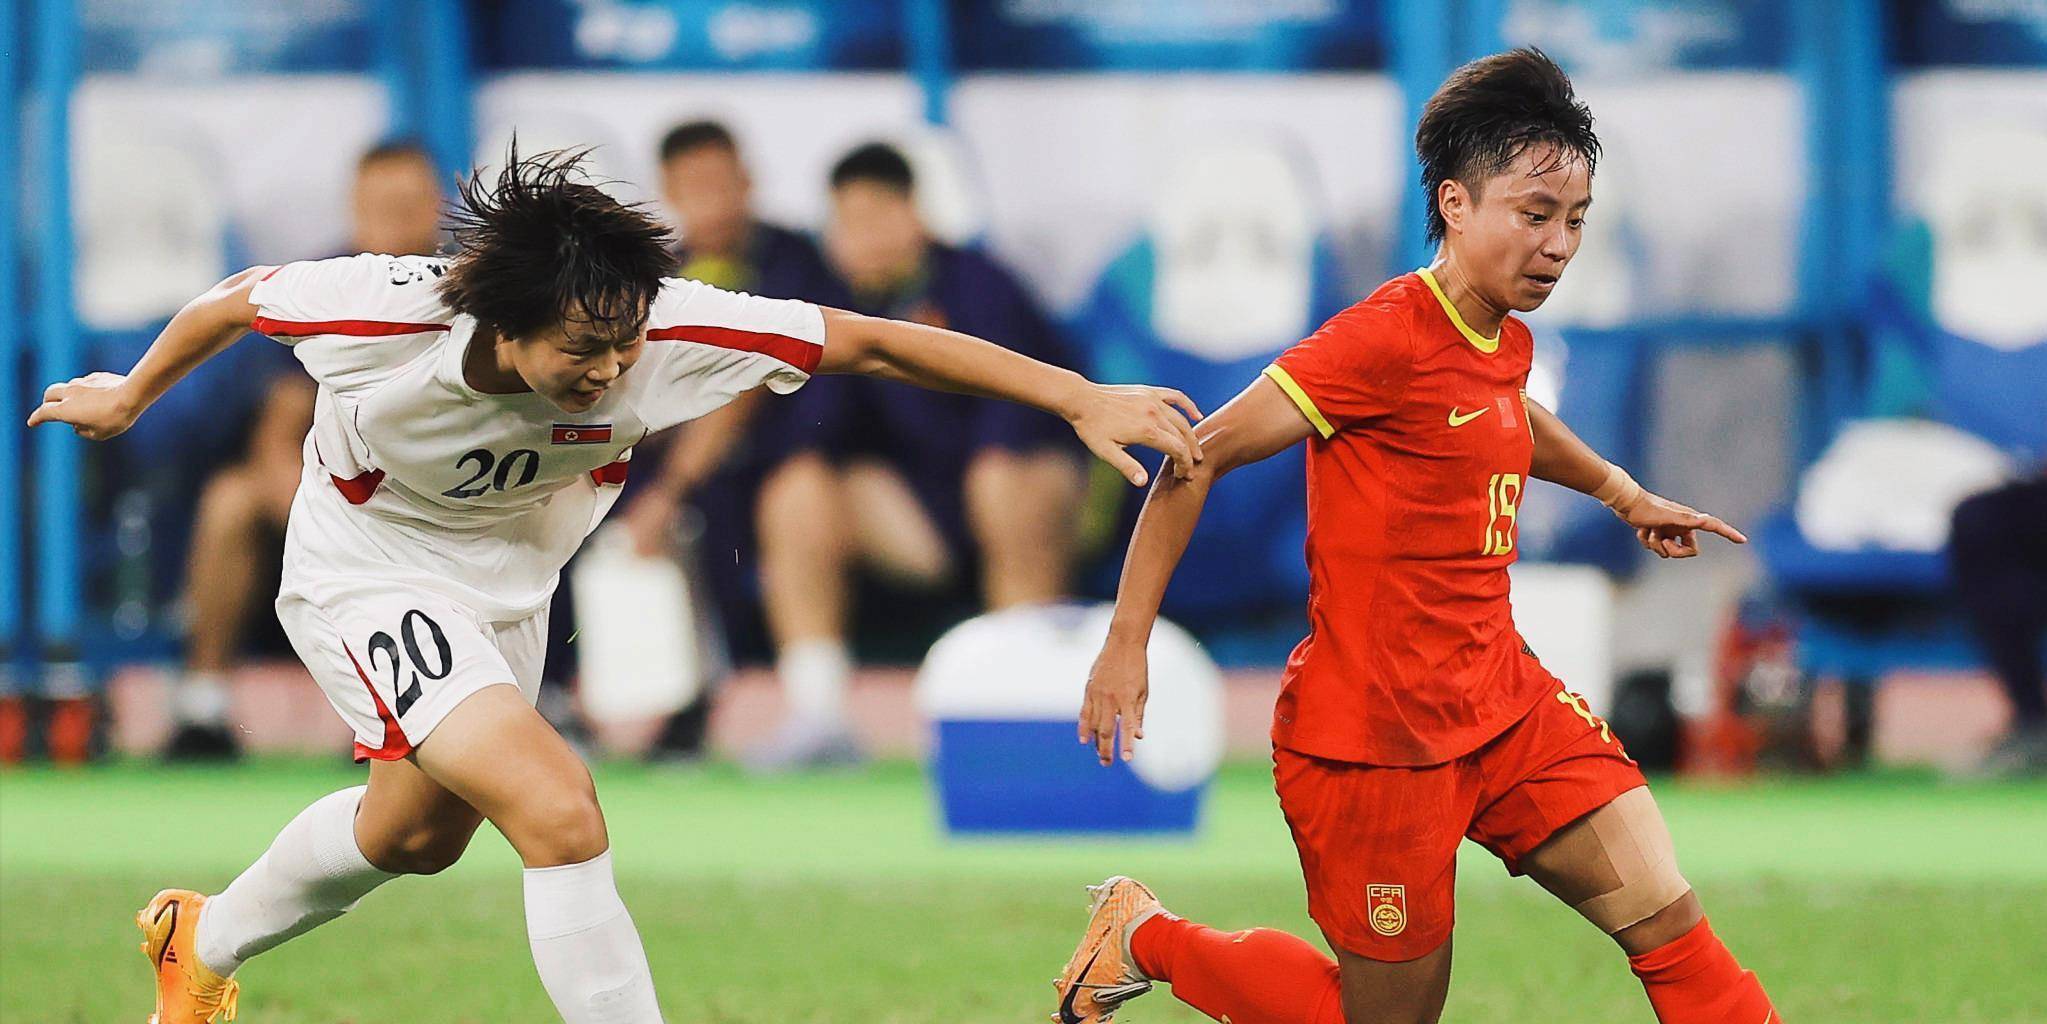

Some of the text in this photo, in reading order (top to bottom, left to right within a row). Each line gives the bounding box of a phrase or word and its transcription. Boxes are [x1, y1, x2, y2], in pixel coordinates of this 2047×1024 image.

[441, 448, 540, 499] 20
[1480, 473, 1520, 556] 19
[368, 609, 453, 719] 20
[1370, 887, 1402, 898] CFA
